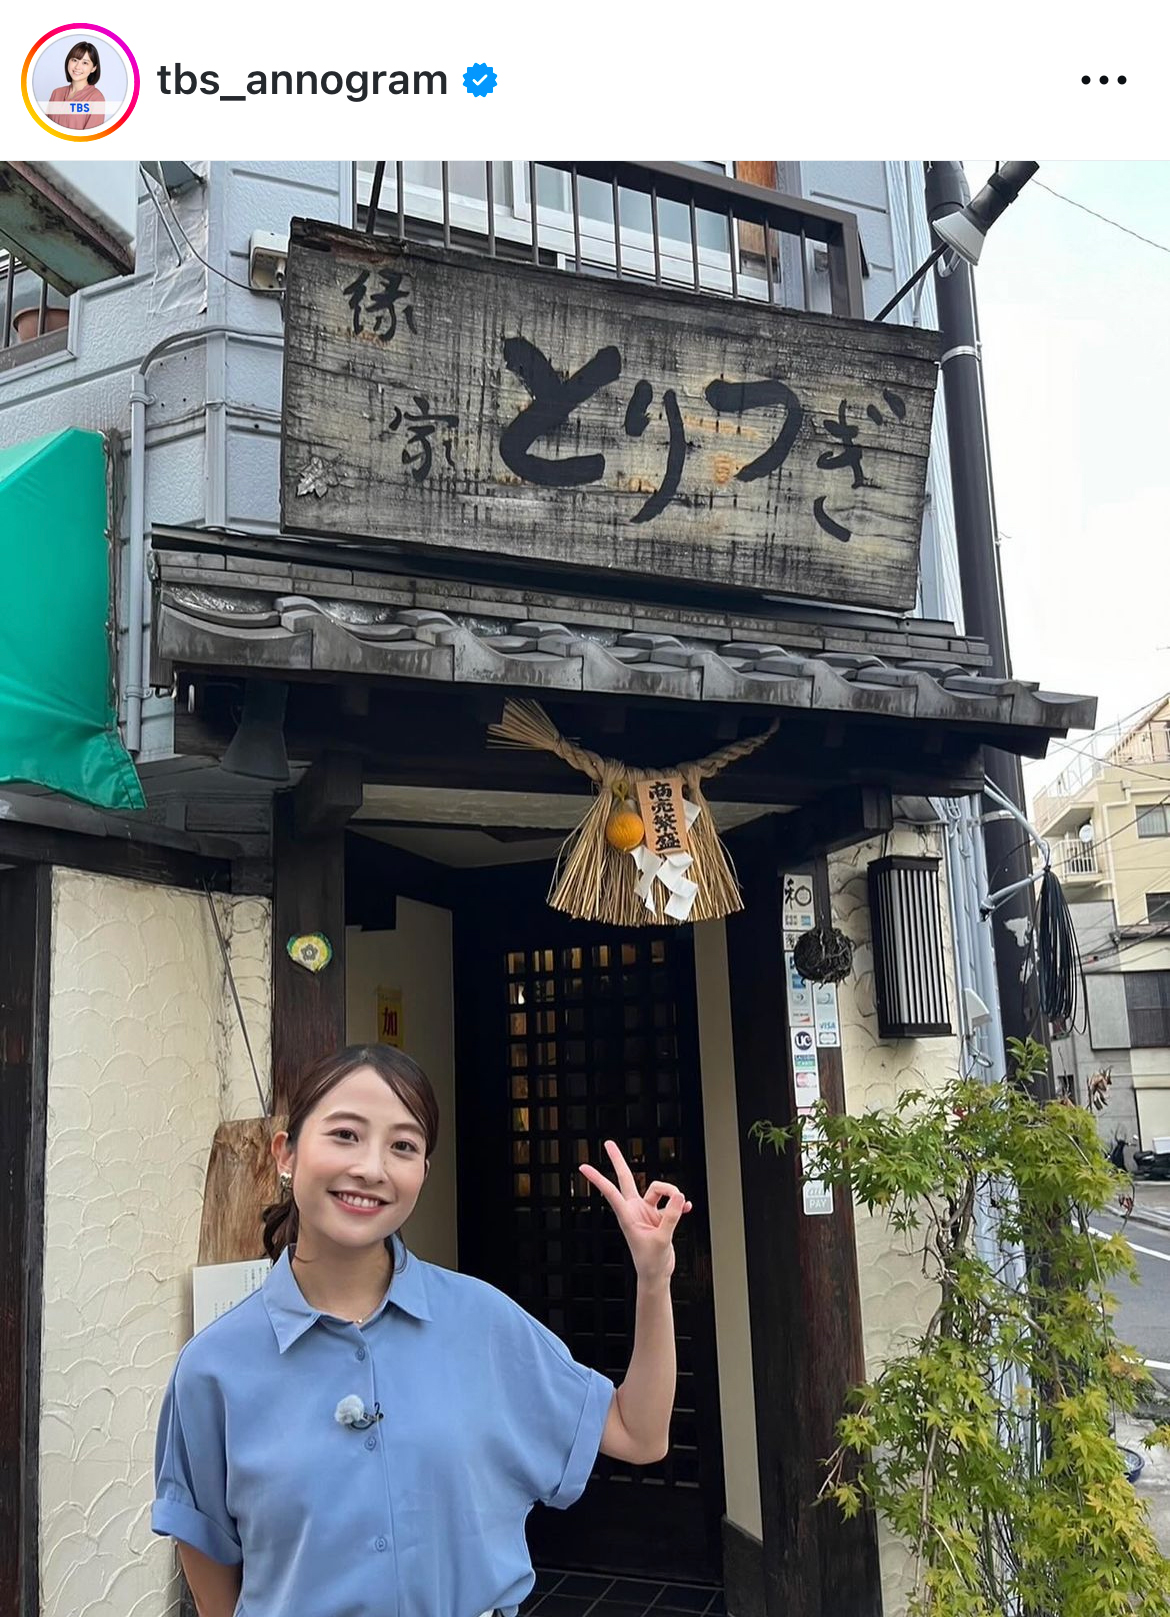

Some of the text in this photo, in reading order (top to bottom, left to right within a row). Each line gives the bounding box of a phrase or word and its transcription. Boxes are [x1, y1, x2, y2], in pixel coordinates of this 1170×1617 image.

[500, 336, 907, 543] とりつぎ
[809, 1198, 827, 1209] PAY
